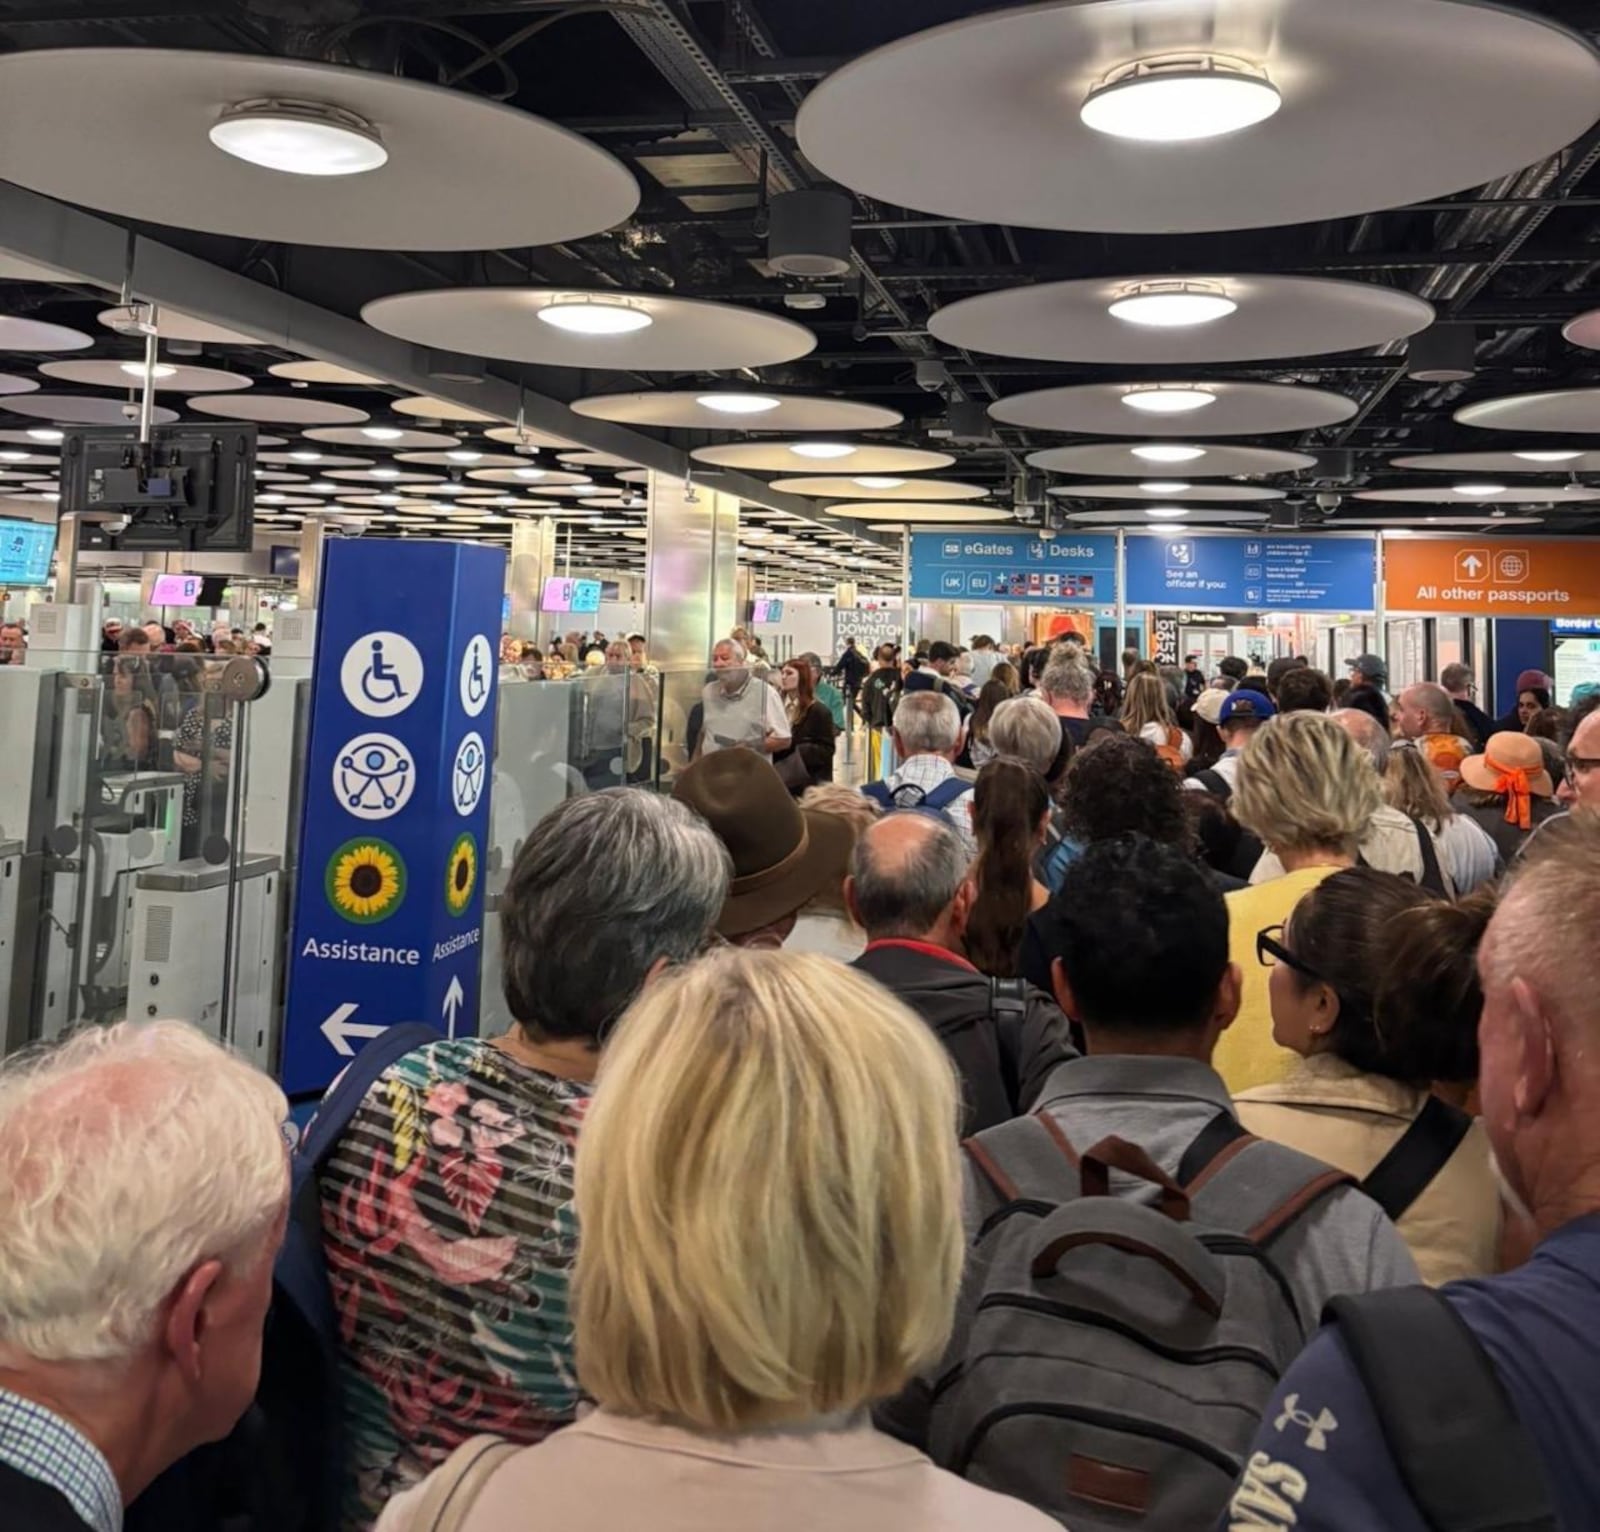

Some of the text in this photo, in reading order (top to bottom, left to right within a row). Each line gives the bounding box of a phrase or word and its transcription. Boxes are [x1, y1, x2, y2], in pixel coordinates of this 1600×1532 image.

[964, 542, 1014, 556] eGates
[1050, 544, 1095, 558] Desks
[1166, 570, 1198, 579] See an
[945, 578, 961, 588] UK
[972, 578, 987, 588] EU
[1166, 579, 1196, 588] officer
[1416, 586, 1570, 604] All other passports
[862, 611, 891, 623] NOT
[1556, 618, 1592, 628] Border
[836, 636, 880, 647] ABEY
[432, 927, 481, 963] Assistance
[302, 937, 421, 966] Assistance
